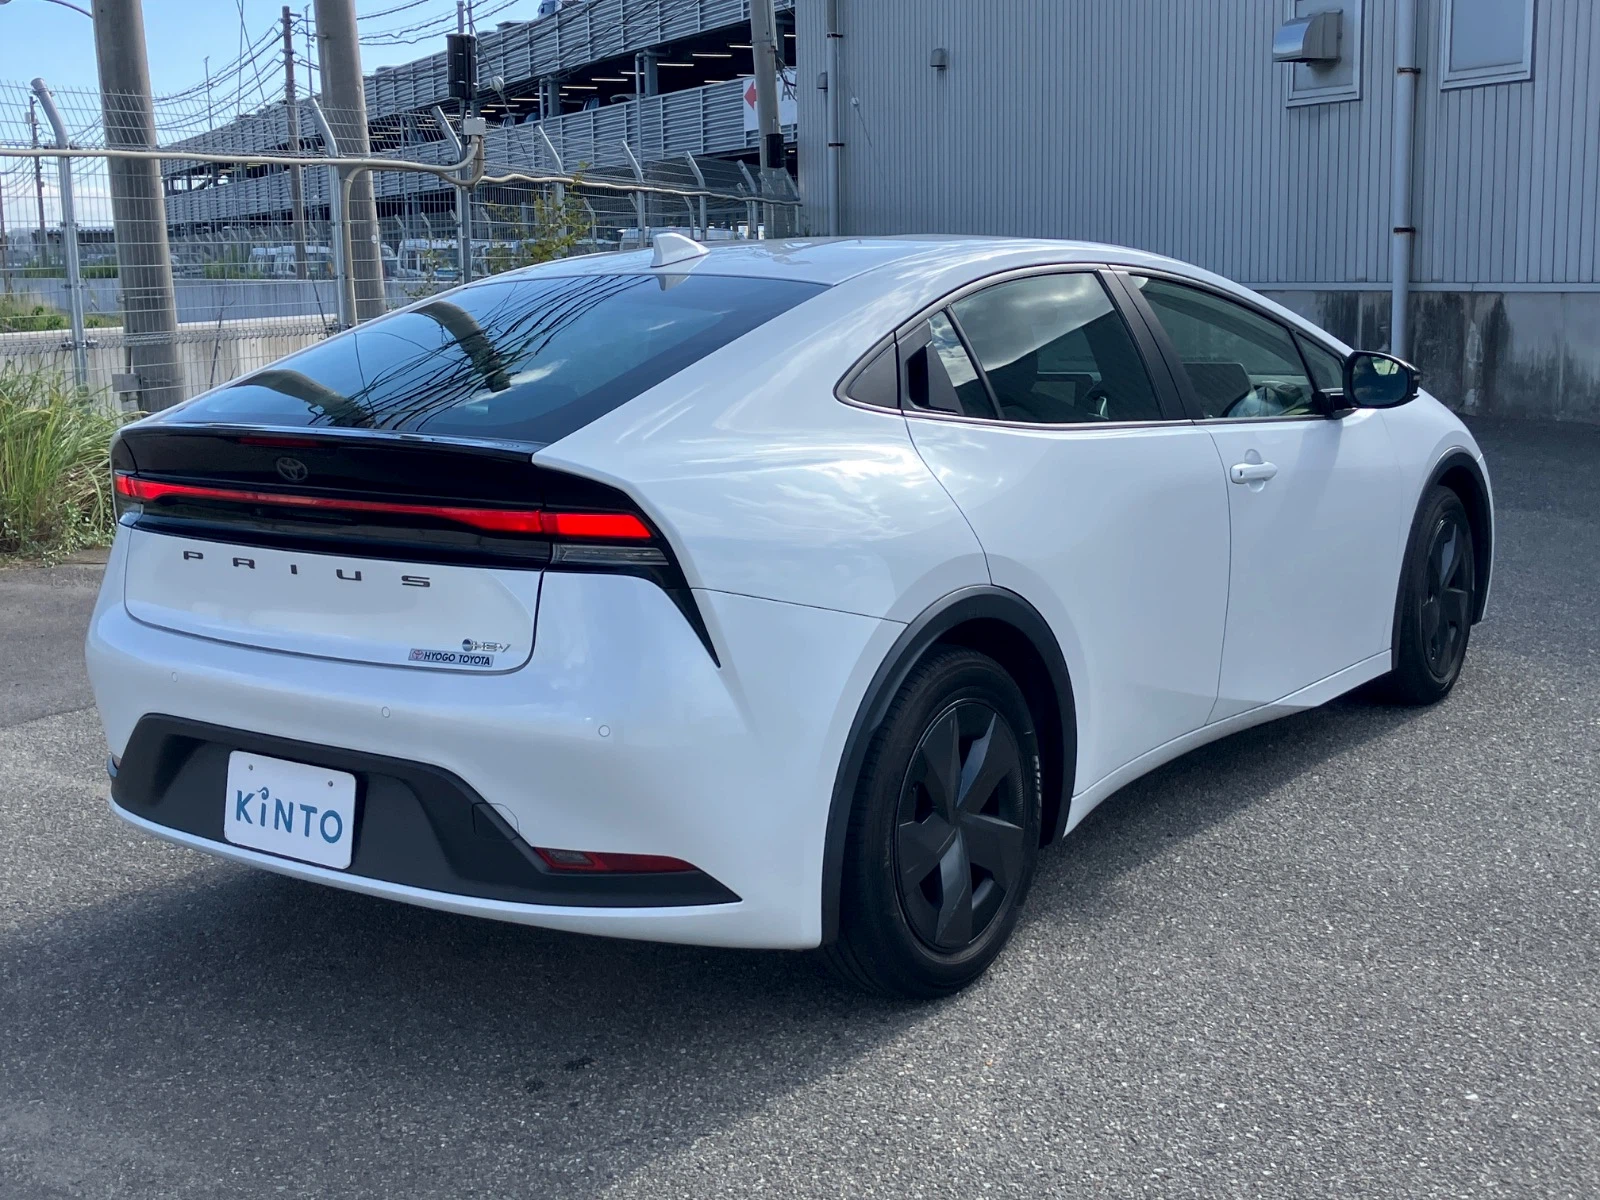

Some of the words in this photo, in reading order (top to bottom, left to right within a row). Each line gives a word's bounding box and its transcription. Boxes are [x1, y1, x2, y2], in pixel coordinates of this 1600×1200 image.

[183, 550, 431, 588] PRIUS
[423, 651, 456, 662] HYOGO
[459, 654, 490, 666] TOYOTA
